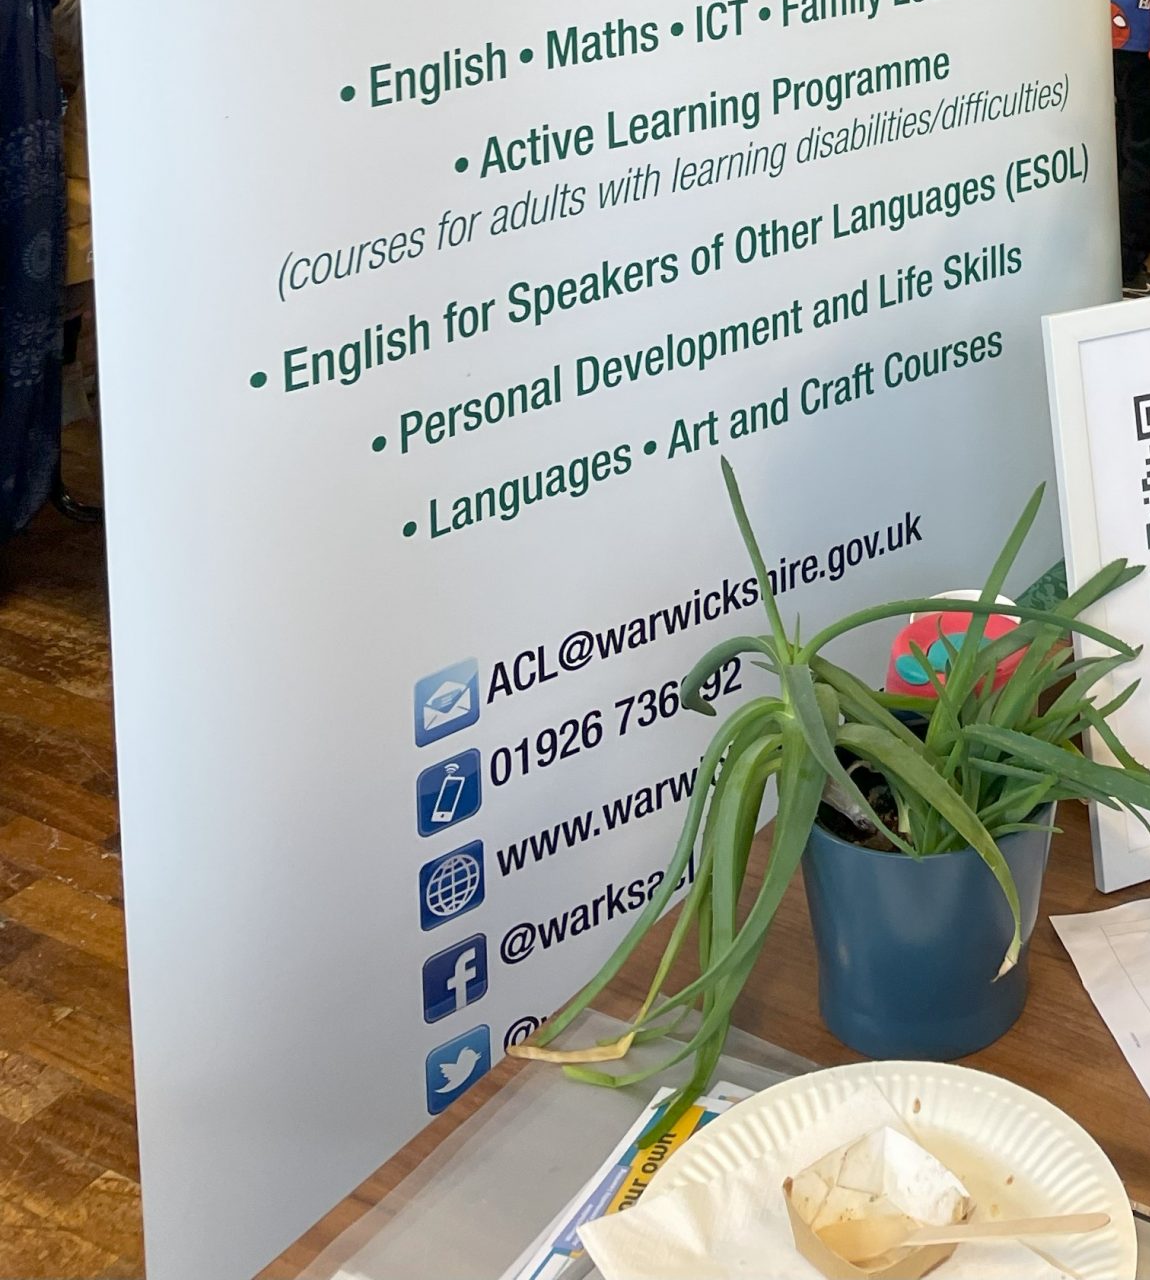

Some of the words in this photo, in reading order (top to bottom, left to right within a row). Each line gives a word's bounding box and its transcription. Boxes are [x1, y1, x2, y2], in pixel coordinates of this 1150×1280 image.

[369, 41, 507, 110] English
[546, 17, 659, 71] Maths
[480, 124, 594, 179] Active
[607, 91, 761, 150] Learning
[772, 51, 951, 123] Programme
[278, 229, 425, 301] (courses
[437, 208, 482, 250] for
[491, 183, 586, 235] adults
[598, 165, 662, 211] with
[673, 125, 787, 194] learning
[796, 73, 1070, 166] disabilities/difficulties)
[282, 315, 431, 394] English
[443, 294, 496, 340] for
[507, 248, 679, 324] Speakers
[690, 233, 725, 274] of
[735, 213, 823, 265] Other
[832, 172, 997, 248] Languages
[1004, 143, 1090, 205] (ESOL)
[399, 374, 562, 455] Personal
[575, 300, 803, 399] Development
[813, 280, 870, 327] and
[879, 266, 934, 310] Life
[943, 240, 1023, 289] Skills
[428, 436, 633, 540] Languages
[668, 412, 719, 460] Art
[729, 391, 790, 438] and
[800, 363, 875, 416] Craft
[884, 329, 1003, 387] Courses
[489, 708, 603, 787] 01926
[614, 657, 743, 738] 73692
[641, 1131, 677, 1177] own
